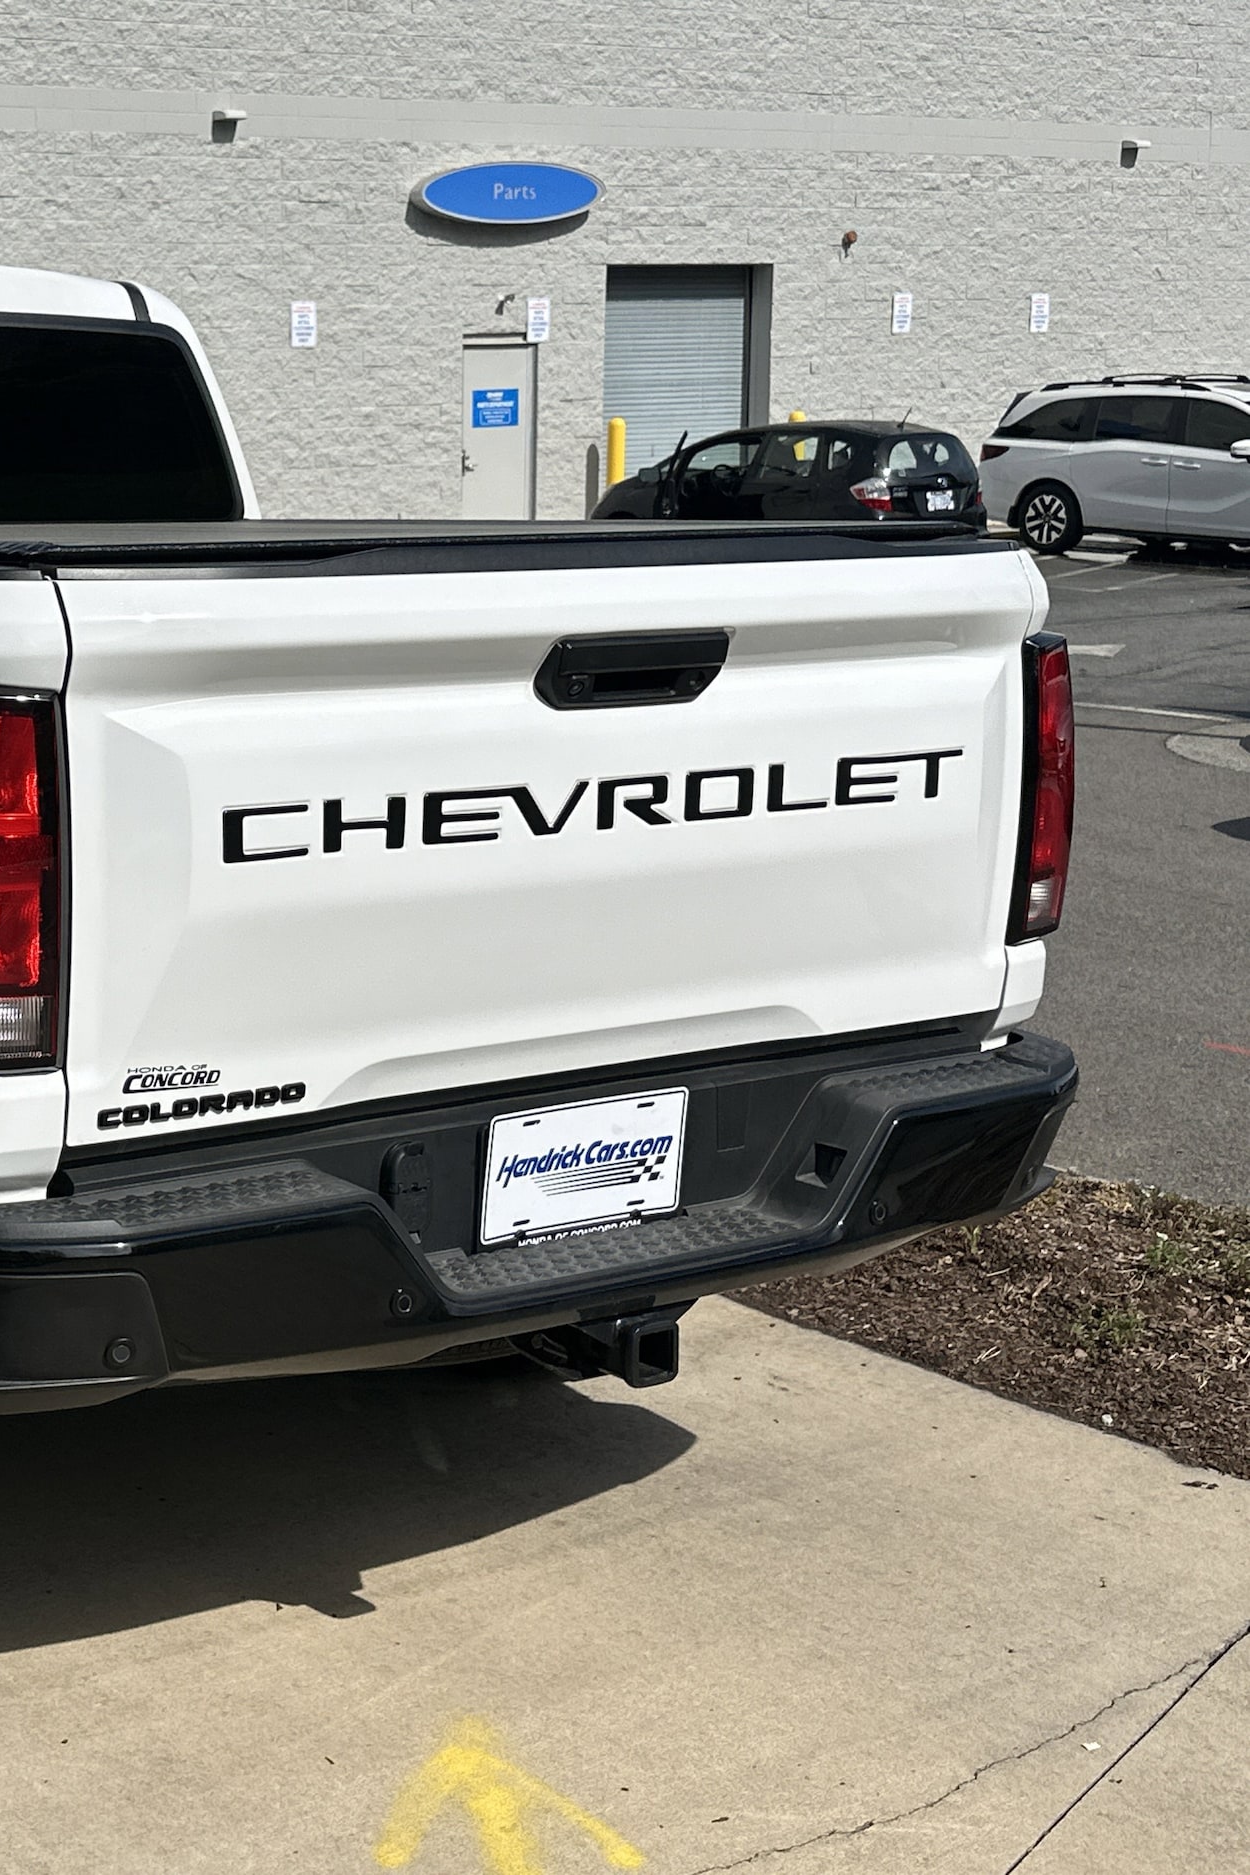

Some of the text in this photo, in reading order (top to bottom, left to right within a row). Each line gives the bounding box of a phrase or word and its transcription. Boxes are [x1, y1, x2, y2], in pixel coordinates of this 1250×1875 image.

[493, 183, 537, 200] Parts
[222, 748, 964, 864] CHEVROLET
[122, 1069, 221, 1094] CONCORD
[127, 1065, 187, 1074] HONDA
[97, 1081, 306, 1130] COLORADO
[495, 1143, 585, 1188] Hendrick
